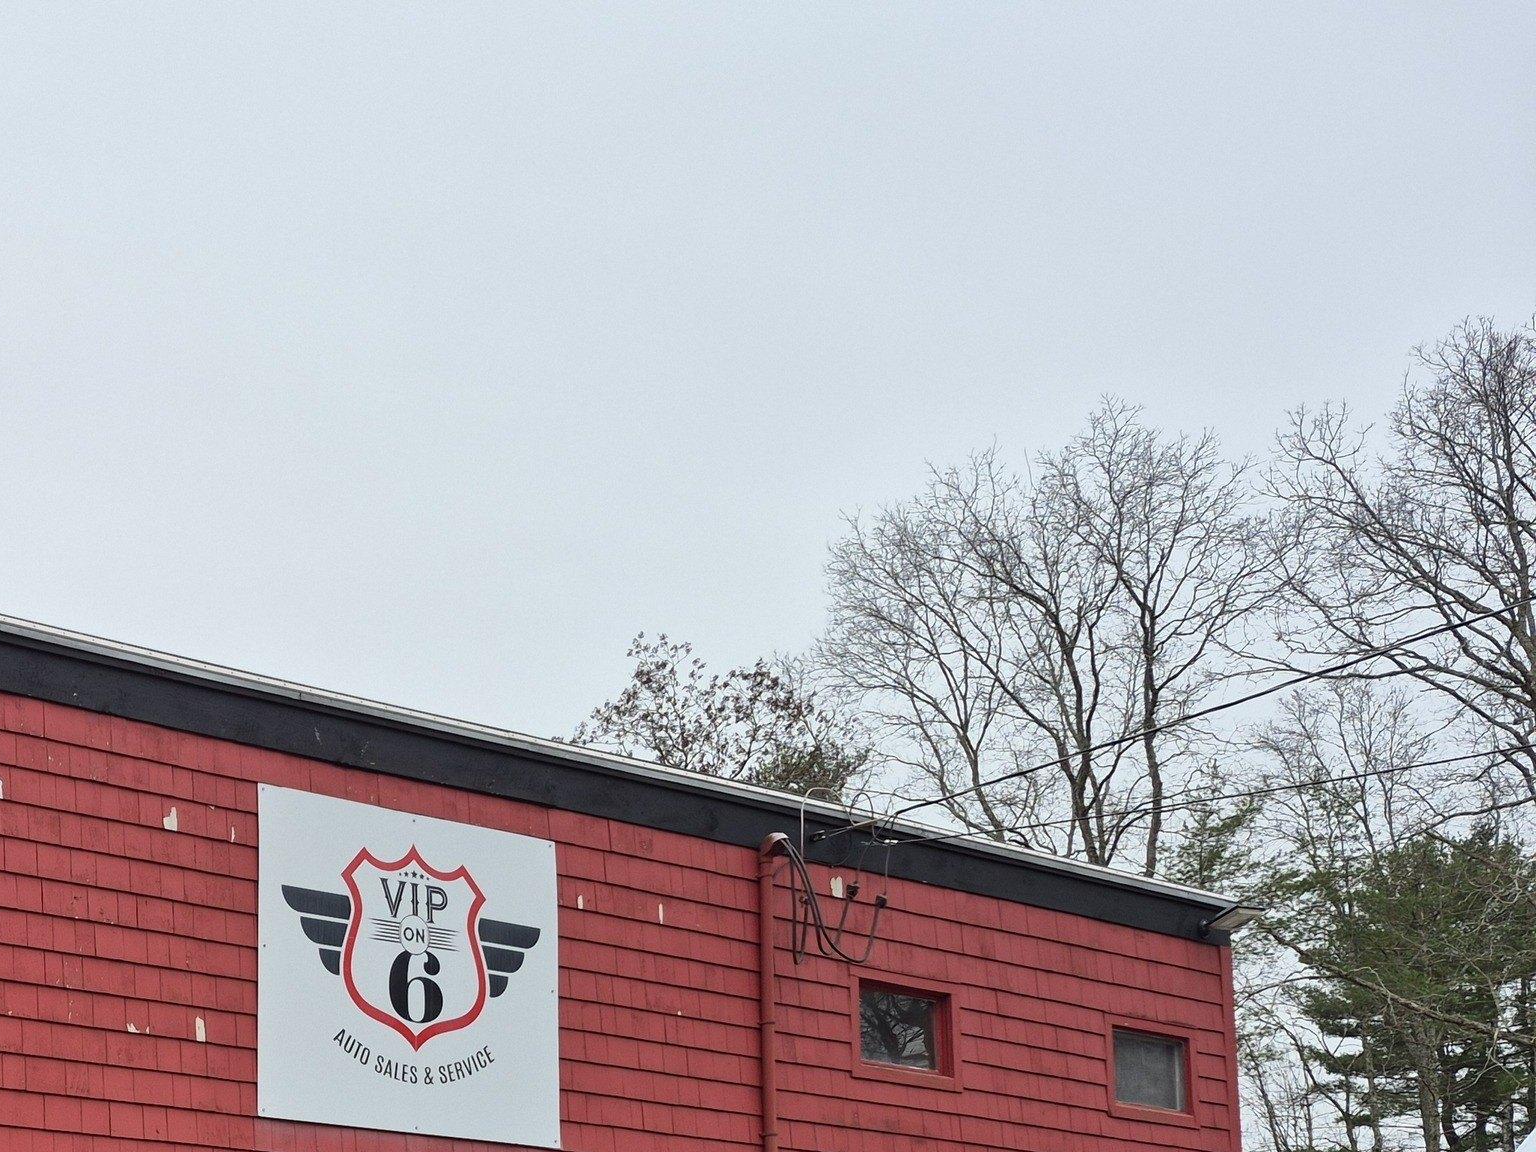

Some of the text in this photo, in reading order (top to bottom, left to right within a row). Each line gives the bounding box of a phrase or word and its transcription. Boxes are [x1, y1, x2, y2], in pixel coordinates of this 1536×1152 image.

[379, 877, 448, 924] VIP
[403, 927, 425, 943] ON
[389, 949, 444, 1024] 6
[333, 1028, 495, 1085] AUTO SALES & SERVICE
